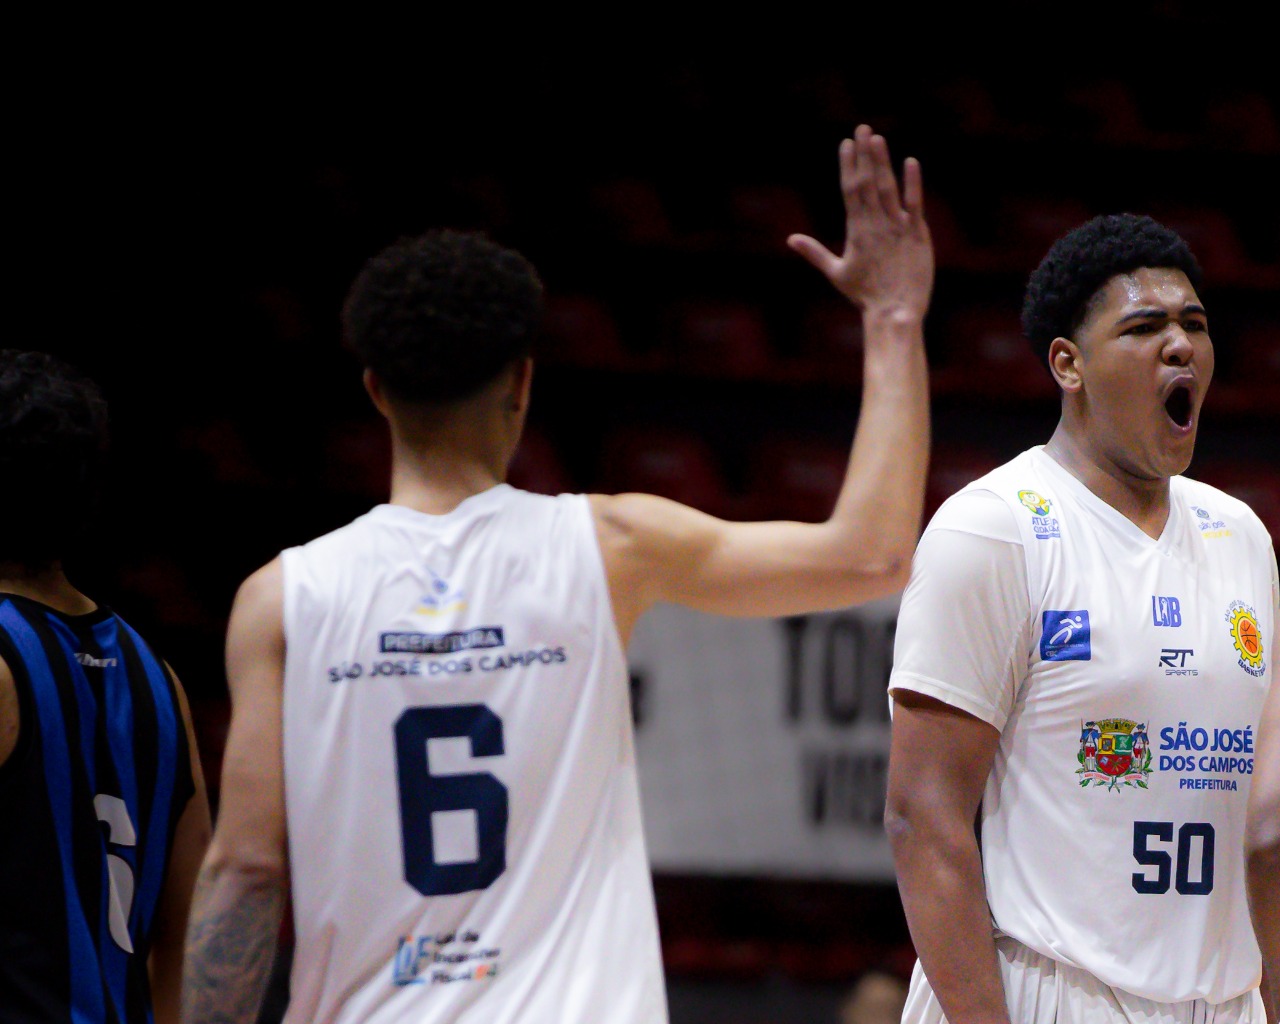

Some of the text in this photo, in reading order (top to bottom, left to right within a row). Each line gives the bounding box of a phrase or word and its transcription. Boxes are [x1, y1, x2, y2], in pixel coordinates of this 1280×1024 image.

[1032, 516, 1059, 526] ATLEA
[428, 656, 473, 676] DOS
[479, 646, 567, 672] CAMPOS
[1159, 649, 1194, 668] RT
[1165, 669, 1199, 677] SPORTS
[1160, 721, 1254, 754] SÃO JOSÉ
[1160, 755, 1254, 775] DOS CAMPOS
[1179, 778, 1237, 792] PREFEITURA
[393, 703, 509, 897] 6
[1132, 820, 1215, 896] 50
